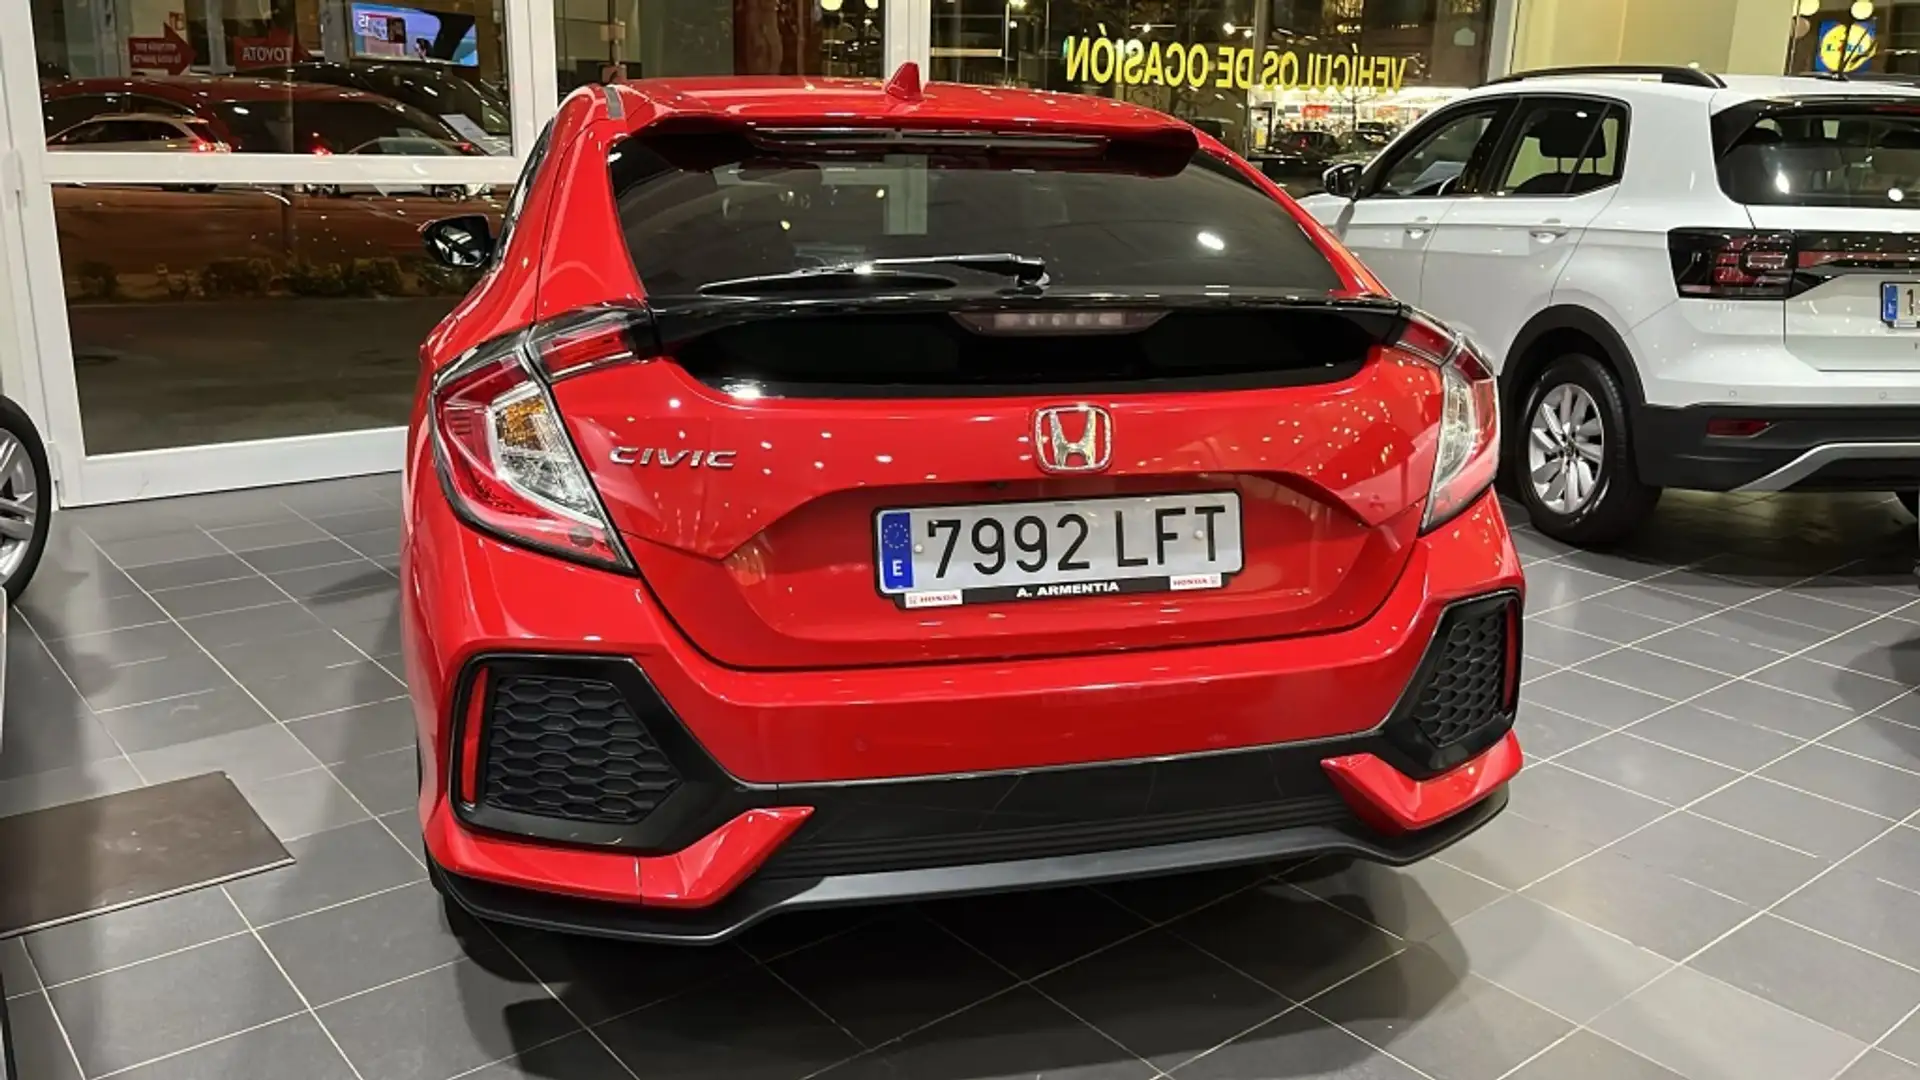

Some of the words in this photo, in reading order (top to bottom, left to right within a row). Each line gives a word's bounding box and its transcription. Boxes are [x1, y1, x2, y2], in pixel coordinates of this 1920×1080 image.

[608, 446, 737, 468] CIVIC
[927, 513, 1091, 579] 7992
[1115, 505, 1226, 568] LFT
[892, 560, 904, 577] E
[1016, 586, 1033, 598] A.
[1037, 581, 1120, 596] ARMENTIA
[1172, 578, 1208, 586] HONDA
[920, 594, 958, 603] HONDA
